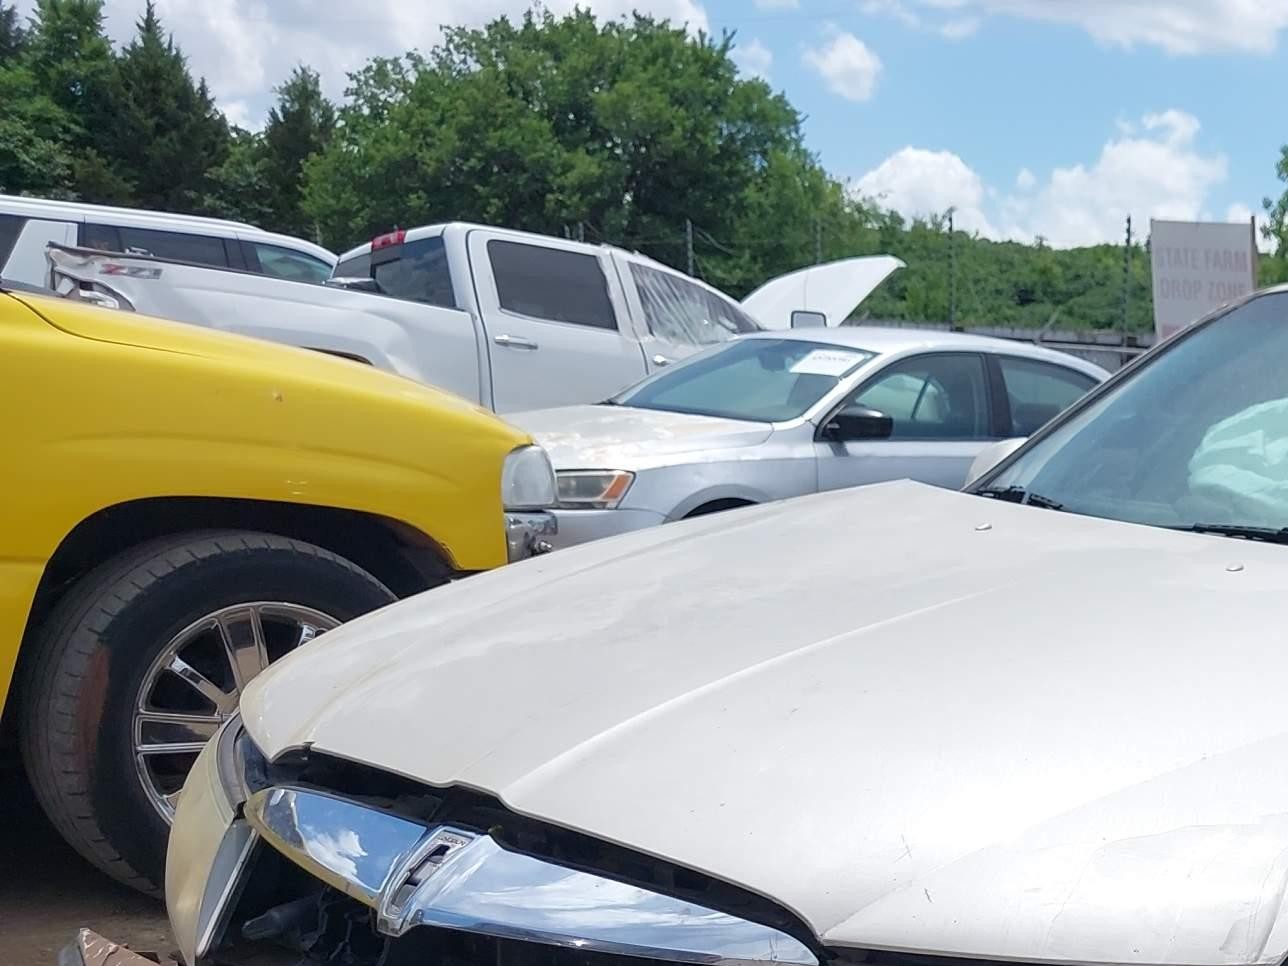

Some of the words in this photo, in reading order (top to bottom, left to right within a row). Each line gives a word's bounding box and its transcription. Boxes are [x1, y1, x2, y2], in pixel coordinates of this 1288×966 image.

[1155, 247, 1200, 270] STATE
[1204, 248, 1247, 272] FARM
[1160, 278, 1202, 301] DROP
[1208, 280, 1246, 302] ZONE
